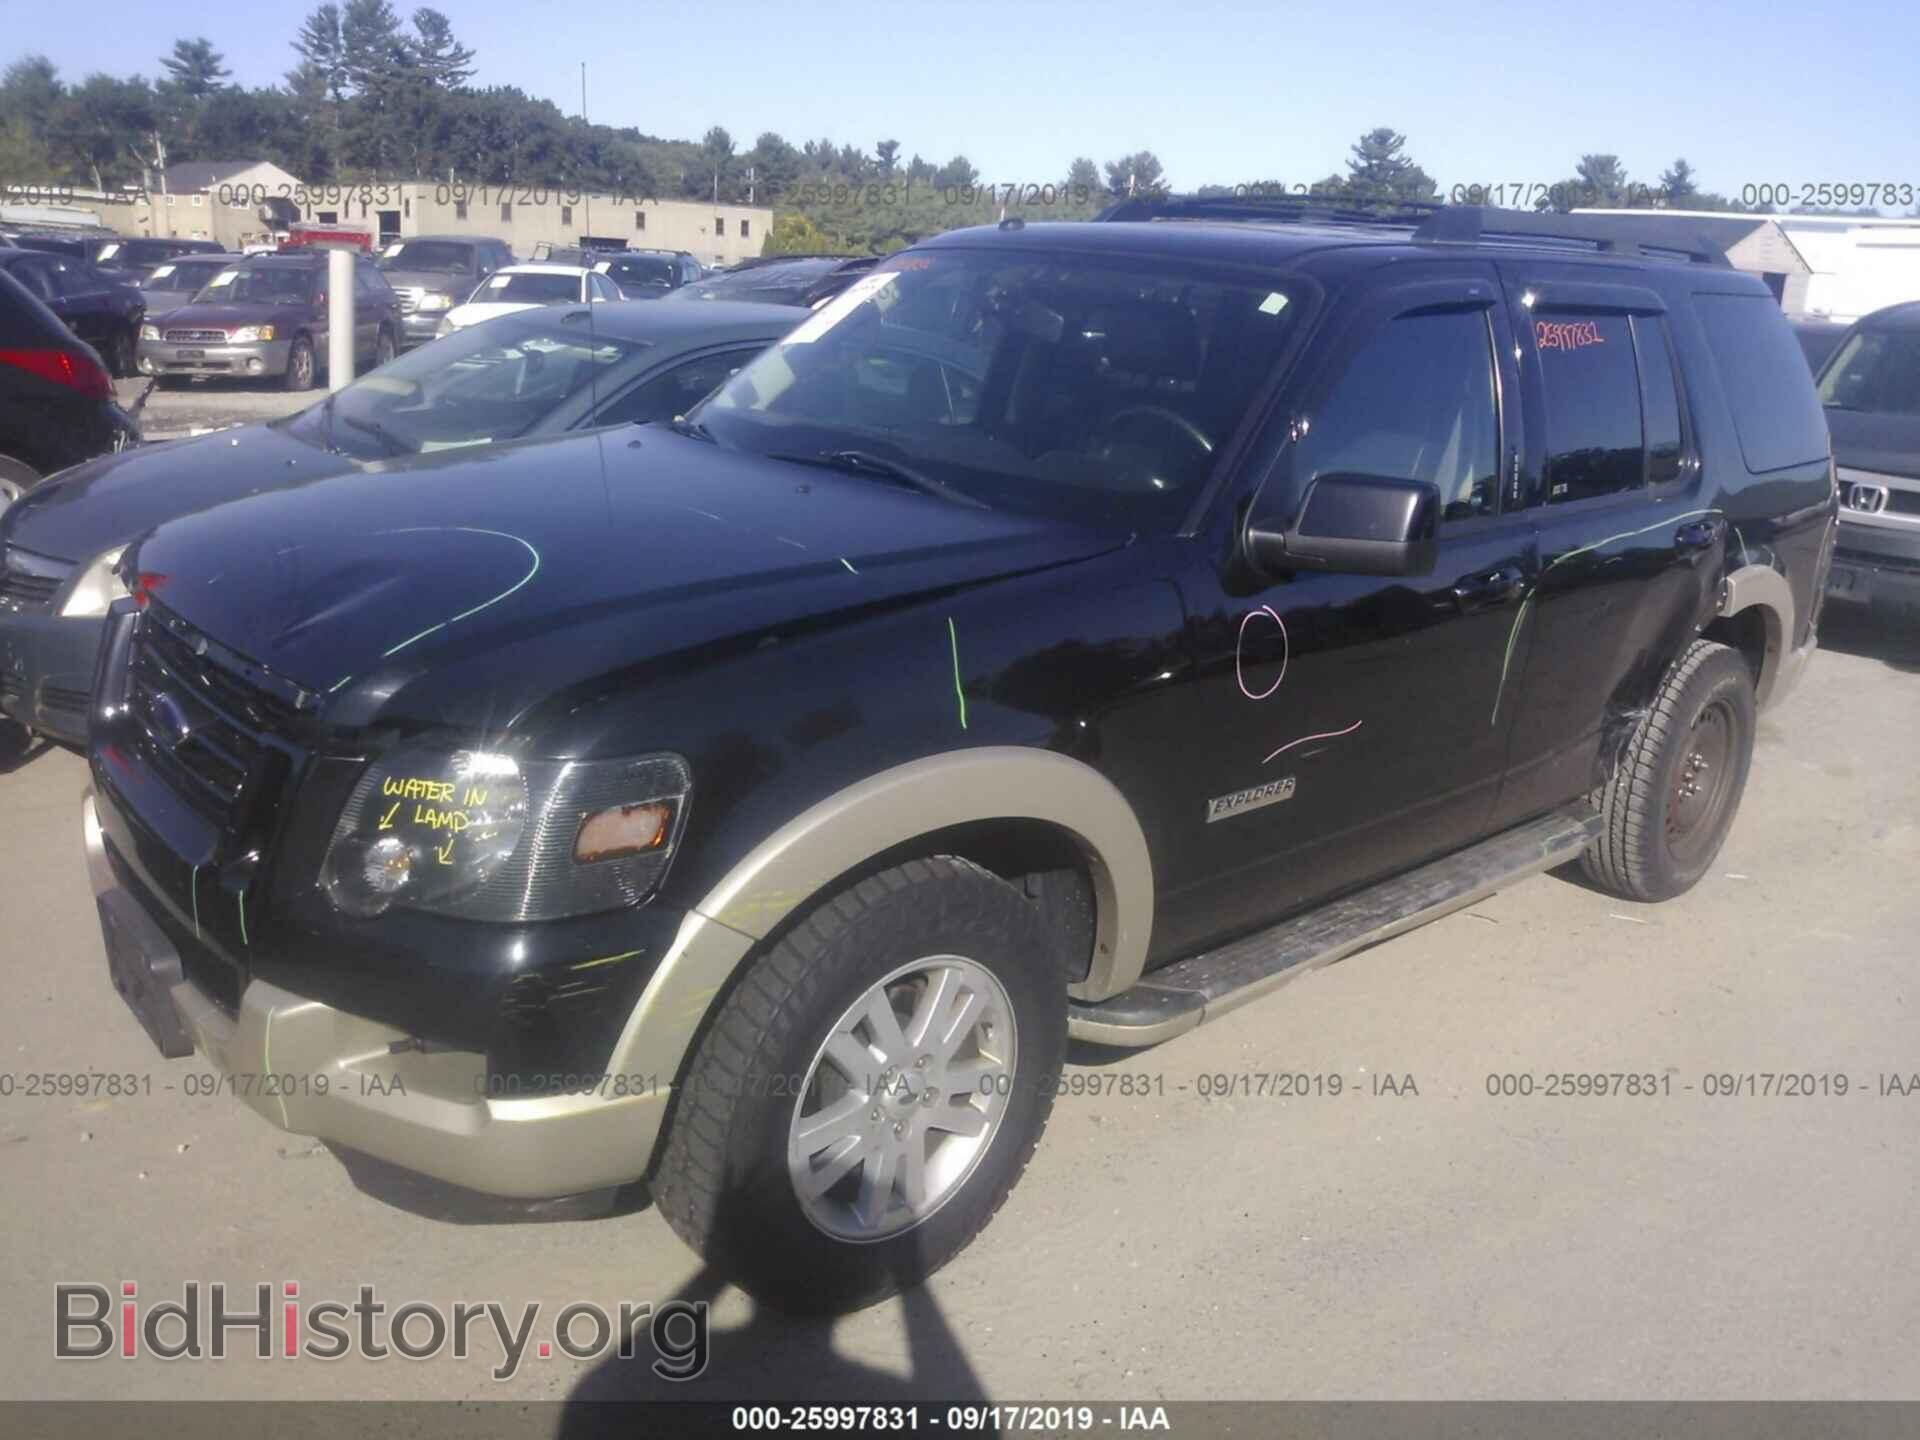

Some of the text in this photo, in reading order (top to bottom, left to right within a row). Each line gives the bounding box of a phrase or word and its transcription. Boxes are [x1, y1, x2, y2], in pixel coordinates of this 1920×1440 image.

[383, 776, 488, 807] WATER IN
[414, 804, 470, 833] LAMP
